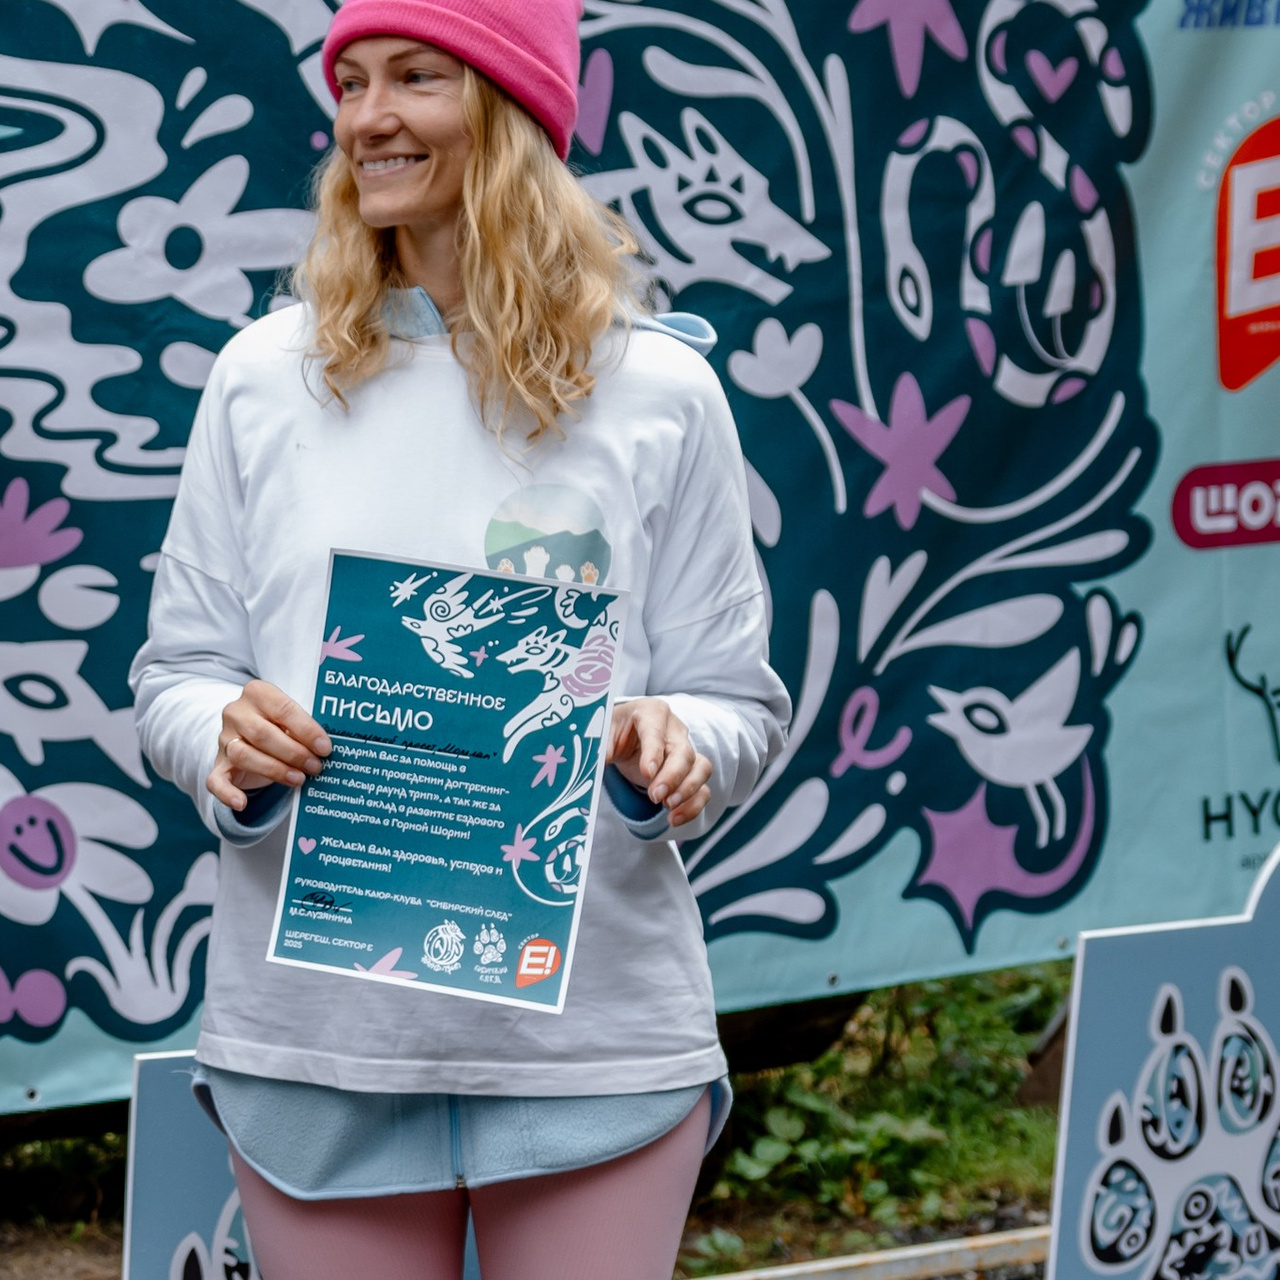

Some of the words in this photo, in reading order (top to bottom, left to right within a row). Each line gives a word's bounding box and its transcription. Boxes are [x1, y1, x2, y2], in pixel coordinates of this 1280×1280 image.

[1198, 90, 1276, 190] СЕКТОР
[324, 670, 506, 711] БЛАГОДАРСТВЕННОЕ
[320, 695, 434, 732] ПИСЬМО
[321, 759, 371, 774] дготовке
[381, 767, 444, 786] проведении
[333, 744, 377, 759] годарим
[413, 756, 457, 772] помощь
[376, 784, 407, 799] раунд
[472, 799, 488, 810] же
[305, 803, 381, 825] собаководства
[391, 818, 428, 834] Горной
[430, 825, 471, 840] Шории!
[366, 798, 397, 813] вклад
[406, 805, 455, 821] развитие
[456, 813, 505, 829] ездового
[318, 852, 392, 872] процветания!
[320, 836, 366, 853] Желаем
[368, 844, 391, 856] Вам
[393, 849, 448, 867] здоровья,
[449, 860, 494, 876] успехов
[294, 877, 364, 896] РУКОВОДИТЕЛЬ
[365, 888, 422, 906] КАЮР-КЛУБА
[283, 939, 302, 950] 2025
[332, 937, 365, 951] СЕКТОР
[520, 945, 557, 975] Е!
